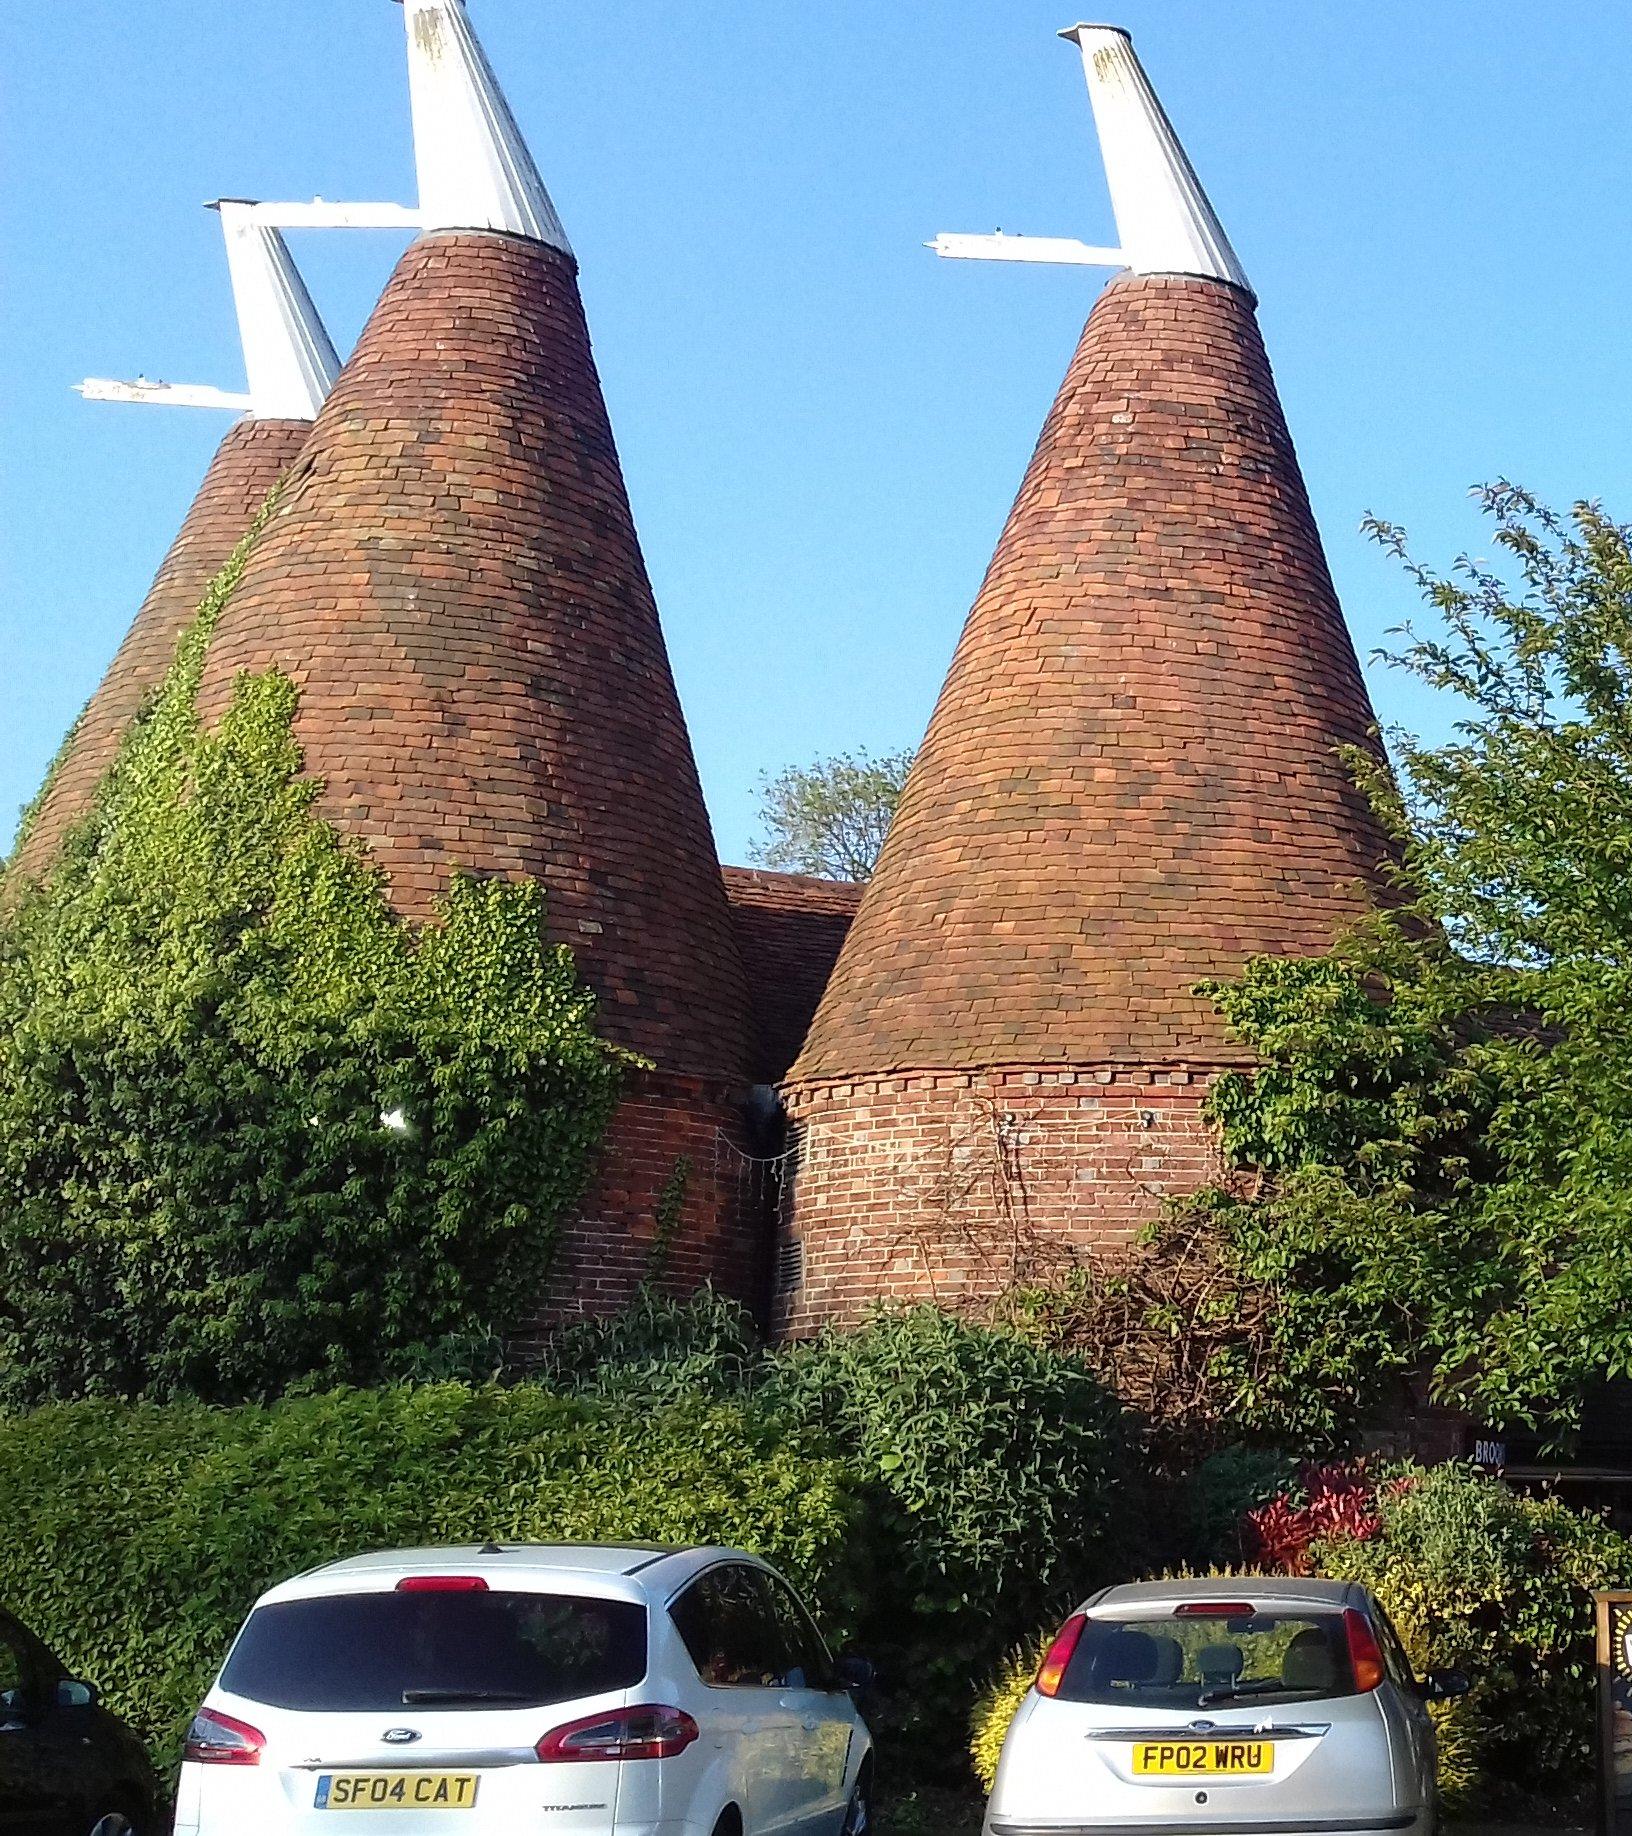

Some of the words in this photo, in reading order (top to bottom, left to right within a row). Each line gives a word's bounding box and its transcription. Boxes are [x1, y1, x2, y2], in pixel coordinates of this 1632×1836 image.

[1143, 1745, 1207, 1769] FP02
[1215, 1744, 1262, 1769] WRU
[333, 1777, 406, 1804] SF04
[414, 1777, 472, 1803] CAT
